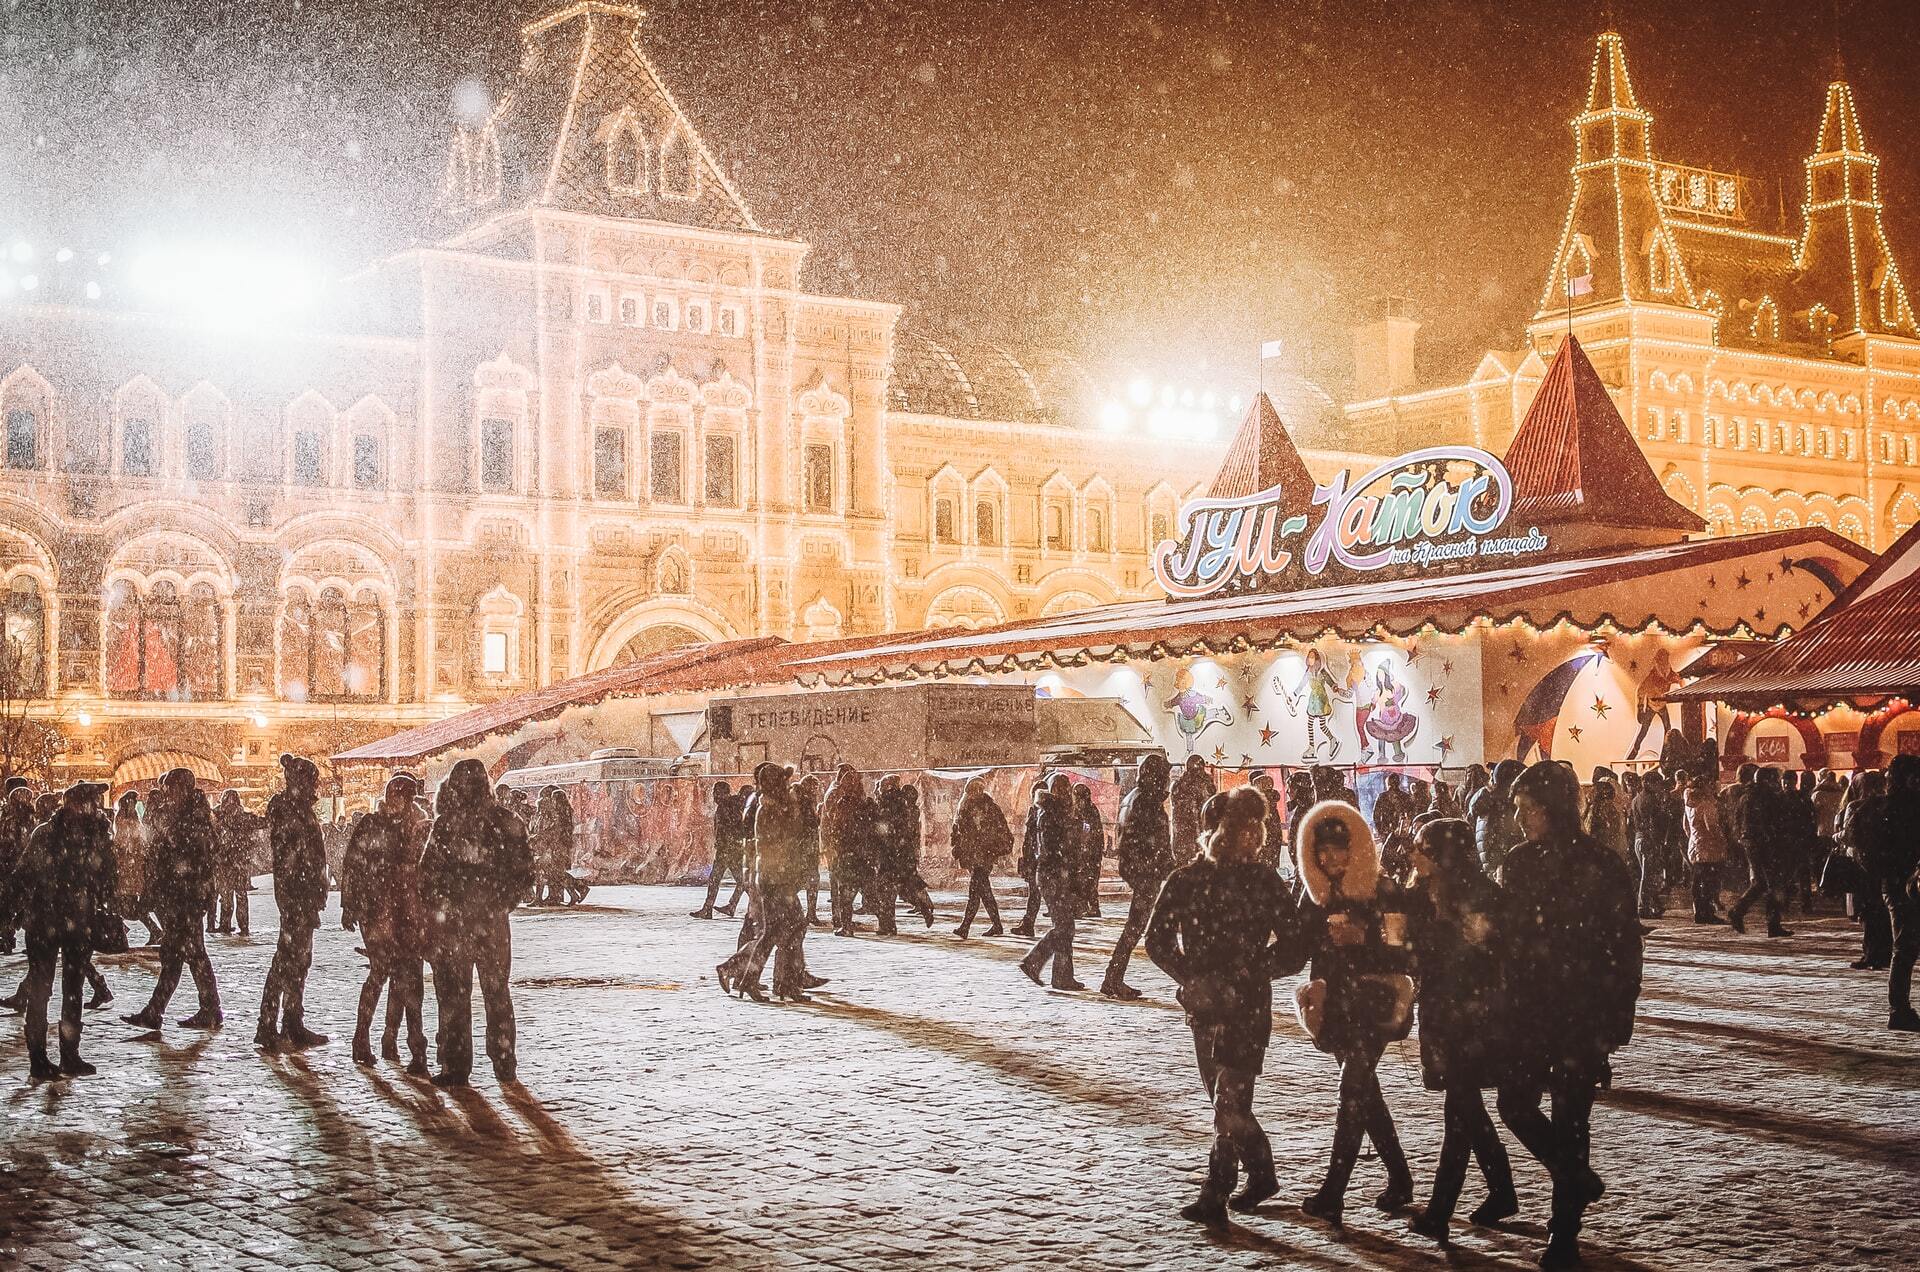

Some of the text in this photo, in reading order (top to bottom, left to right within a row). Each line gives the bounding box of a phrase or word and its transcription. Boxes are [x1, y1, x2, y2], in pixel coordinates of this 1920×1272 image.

[1390, 527, 1548, 568] на Красной площади
[748, 706, 871, 729] ТЕЛЕВИДЕНИЕ
[1759, 740, 1786, 756] КАССА
